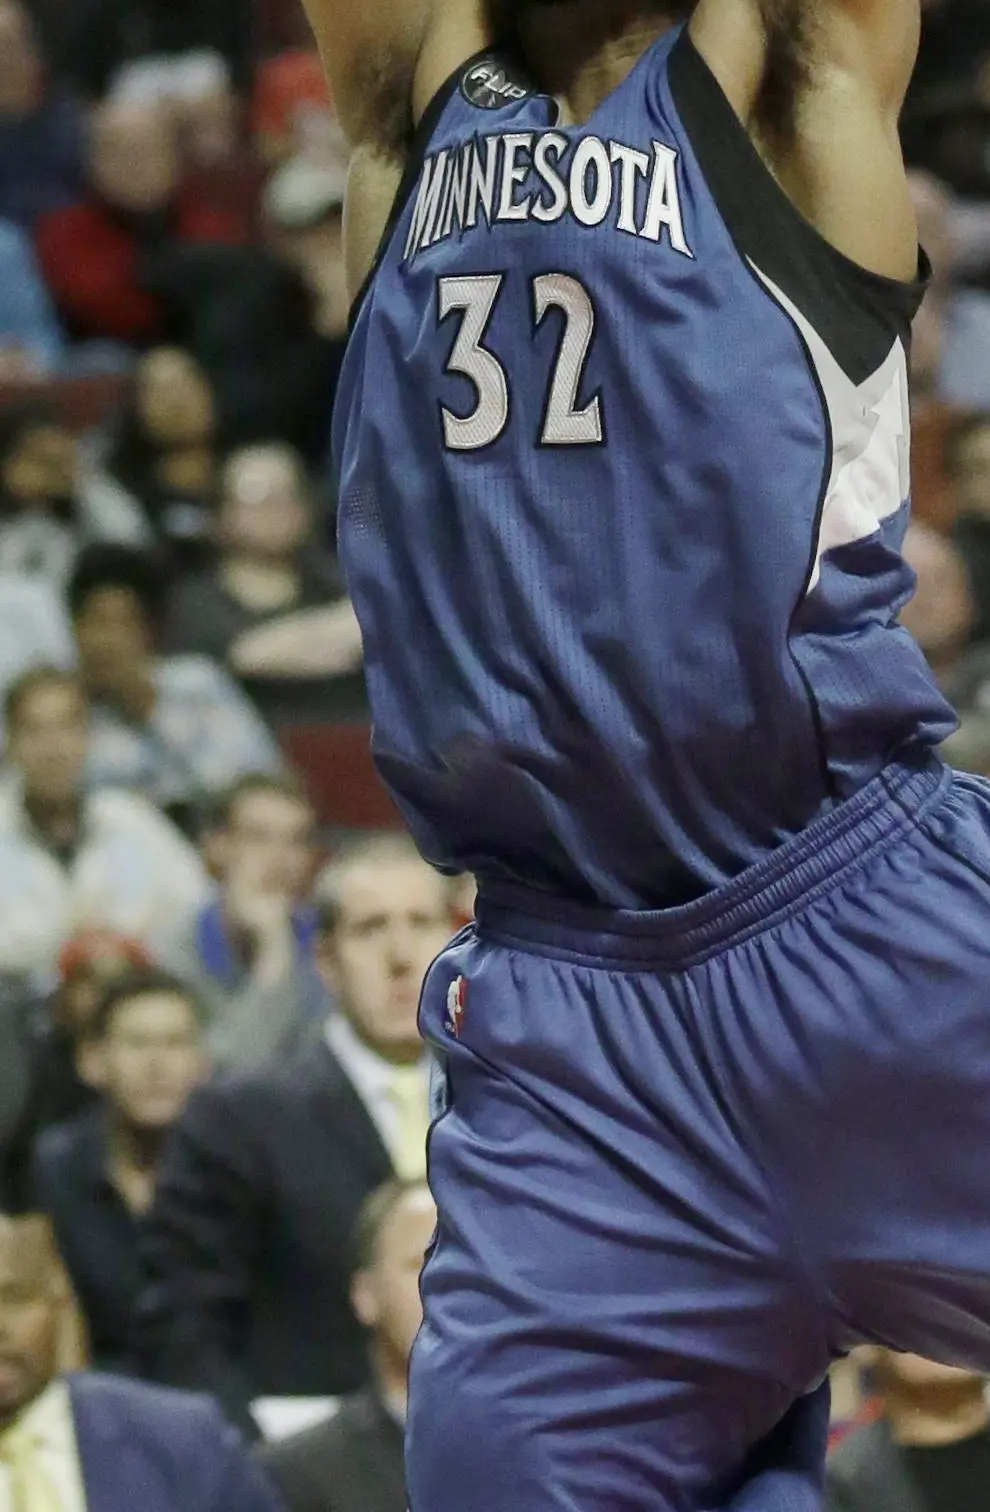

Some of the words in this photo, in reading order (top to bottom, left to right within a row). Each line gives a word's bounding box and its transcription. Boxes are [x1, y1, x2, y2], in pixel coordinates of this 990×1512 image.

[470, 68, 527, 99] FLIP
[400, 130, 697, 265] MINNESOTA
[434, 272, 606, 452] 32
